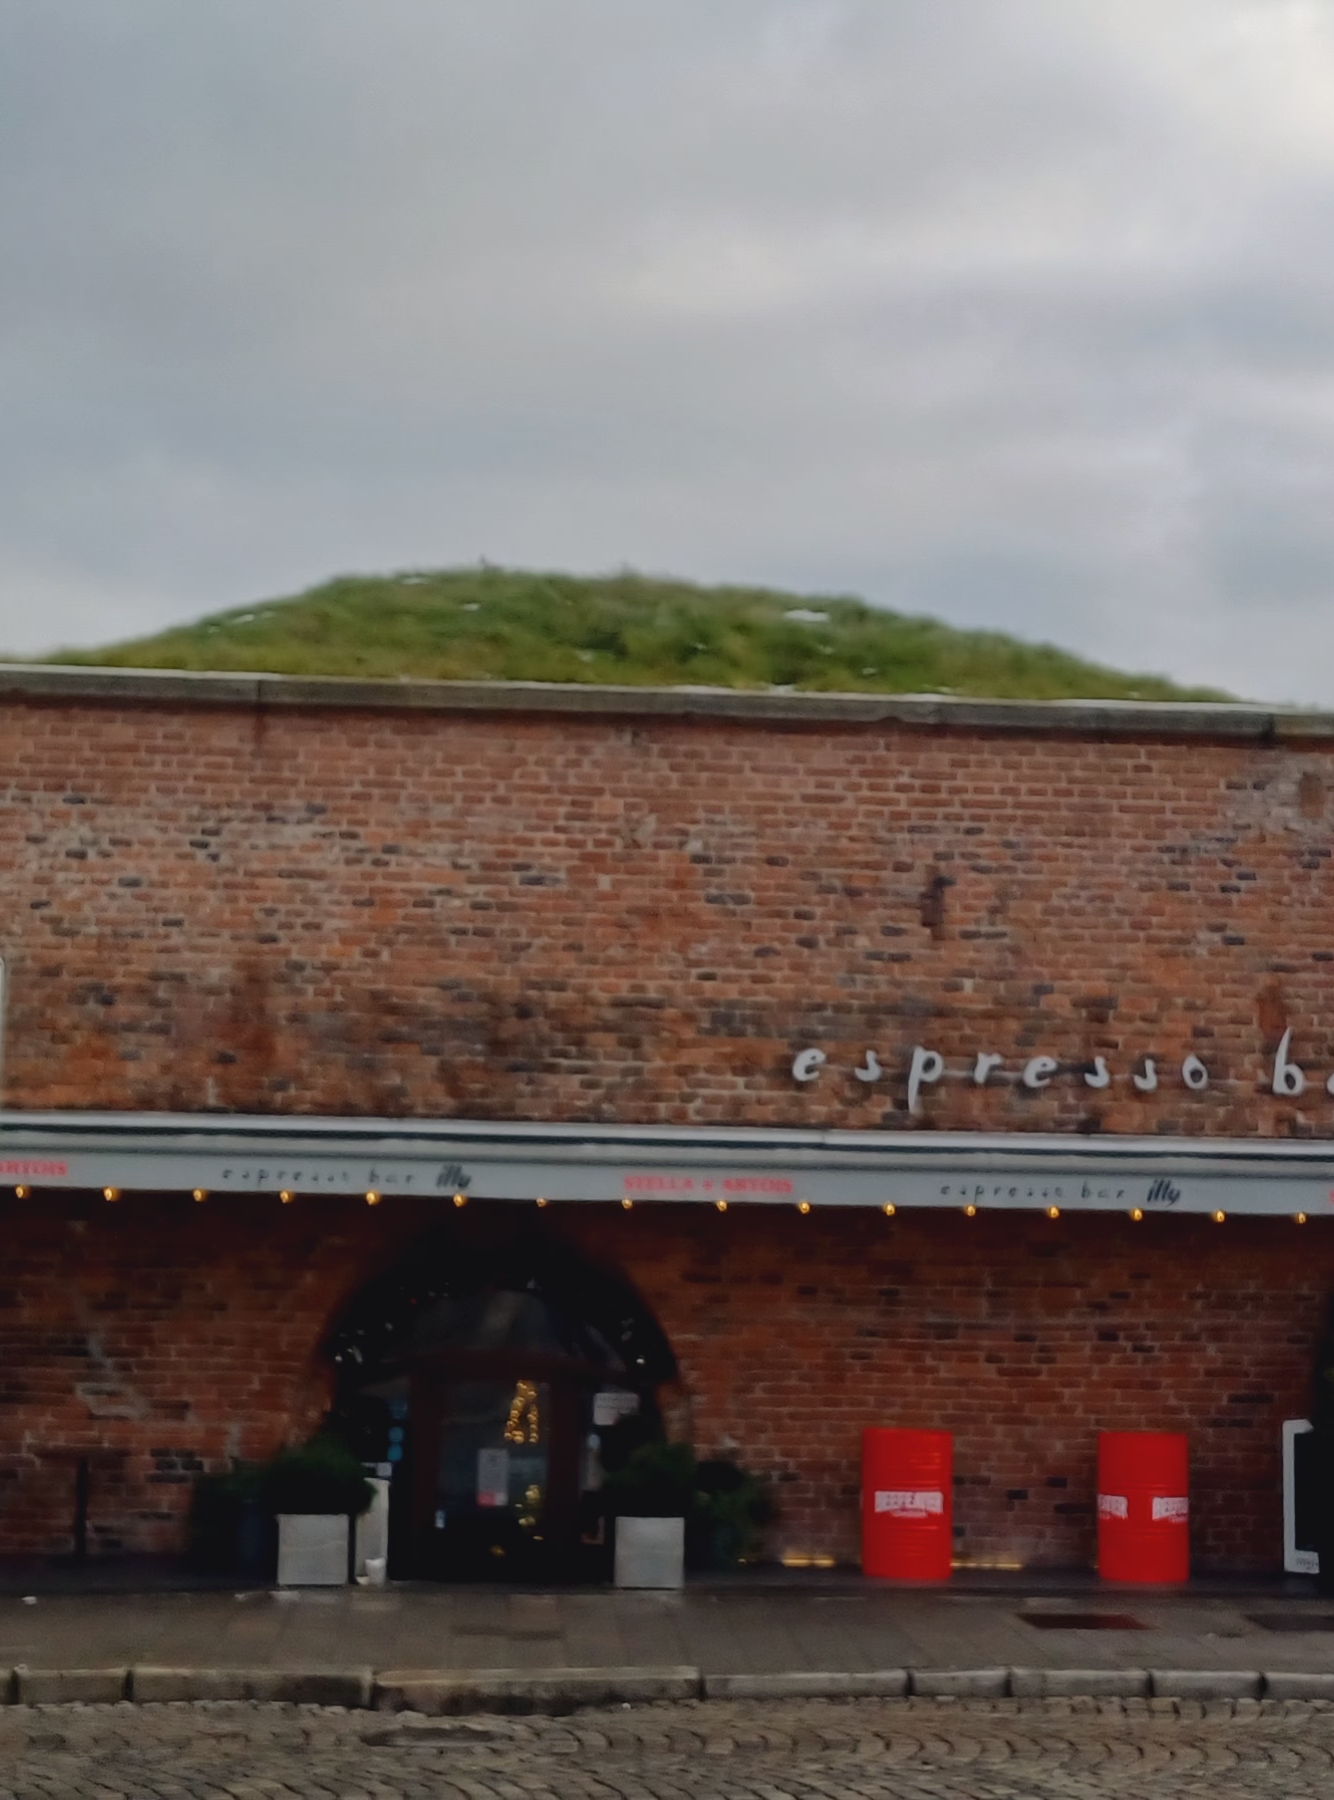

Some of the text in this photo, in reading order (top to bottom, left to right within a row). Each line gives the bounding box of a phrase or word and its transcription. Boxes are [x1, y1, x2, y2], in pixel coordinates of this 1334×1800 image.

[791, 1046, 1209, 1114] espresso
[1080, 1179, 1126, 1200] bar
[1147, 1178, 1181, 1206] illy
